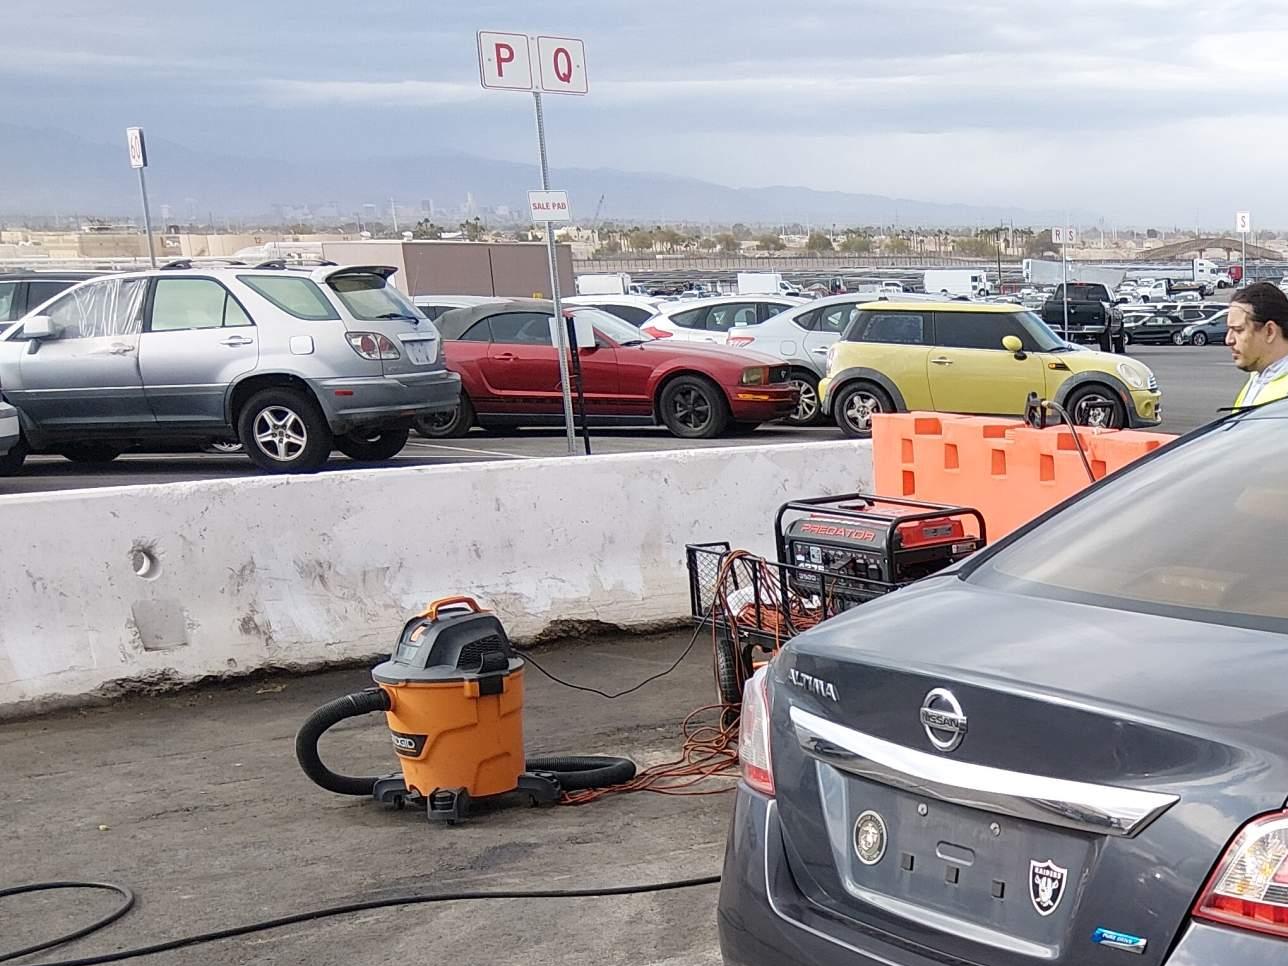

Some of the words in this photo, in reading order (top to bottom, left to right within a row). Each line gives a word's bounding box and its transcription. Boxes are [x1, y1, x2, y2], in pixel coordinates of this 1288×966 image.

[495, 42, 515, 77] P
[553, 47, 572, 83] Q
[532, 202, 550, 210] SALE
[552, 202, 567, 210] PAD
[800, 523, 877, 542] PREDATOR
[788, 668, 840, 702] ALTIMA
[922, 711, 960, 729] NISSAN
[1034, 867, 1062, 880] RAIDERS
